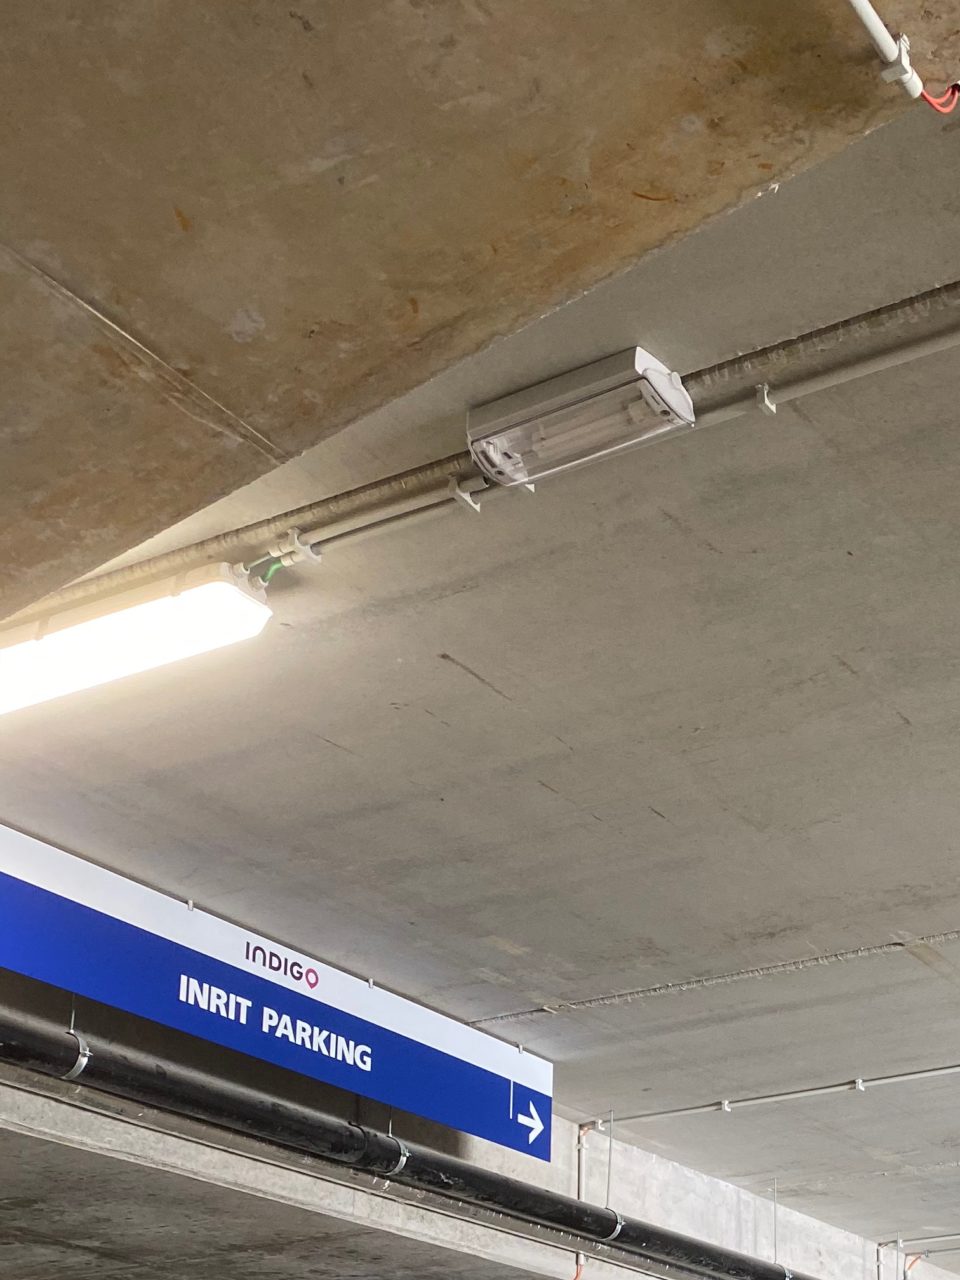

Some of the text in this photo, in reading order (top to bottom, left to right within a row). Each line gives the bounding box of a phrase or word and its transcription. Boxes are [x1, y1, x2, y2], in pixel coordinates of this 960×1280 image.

[245, 941, 320, 990] INDIGO
[179, 974, 372, 1072] INRIT PARKING
